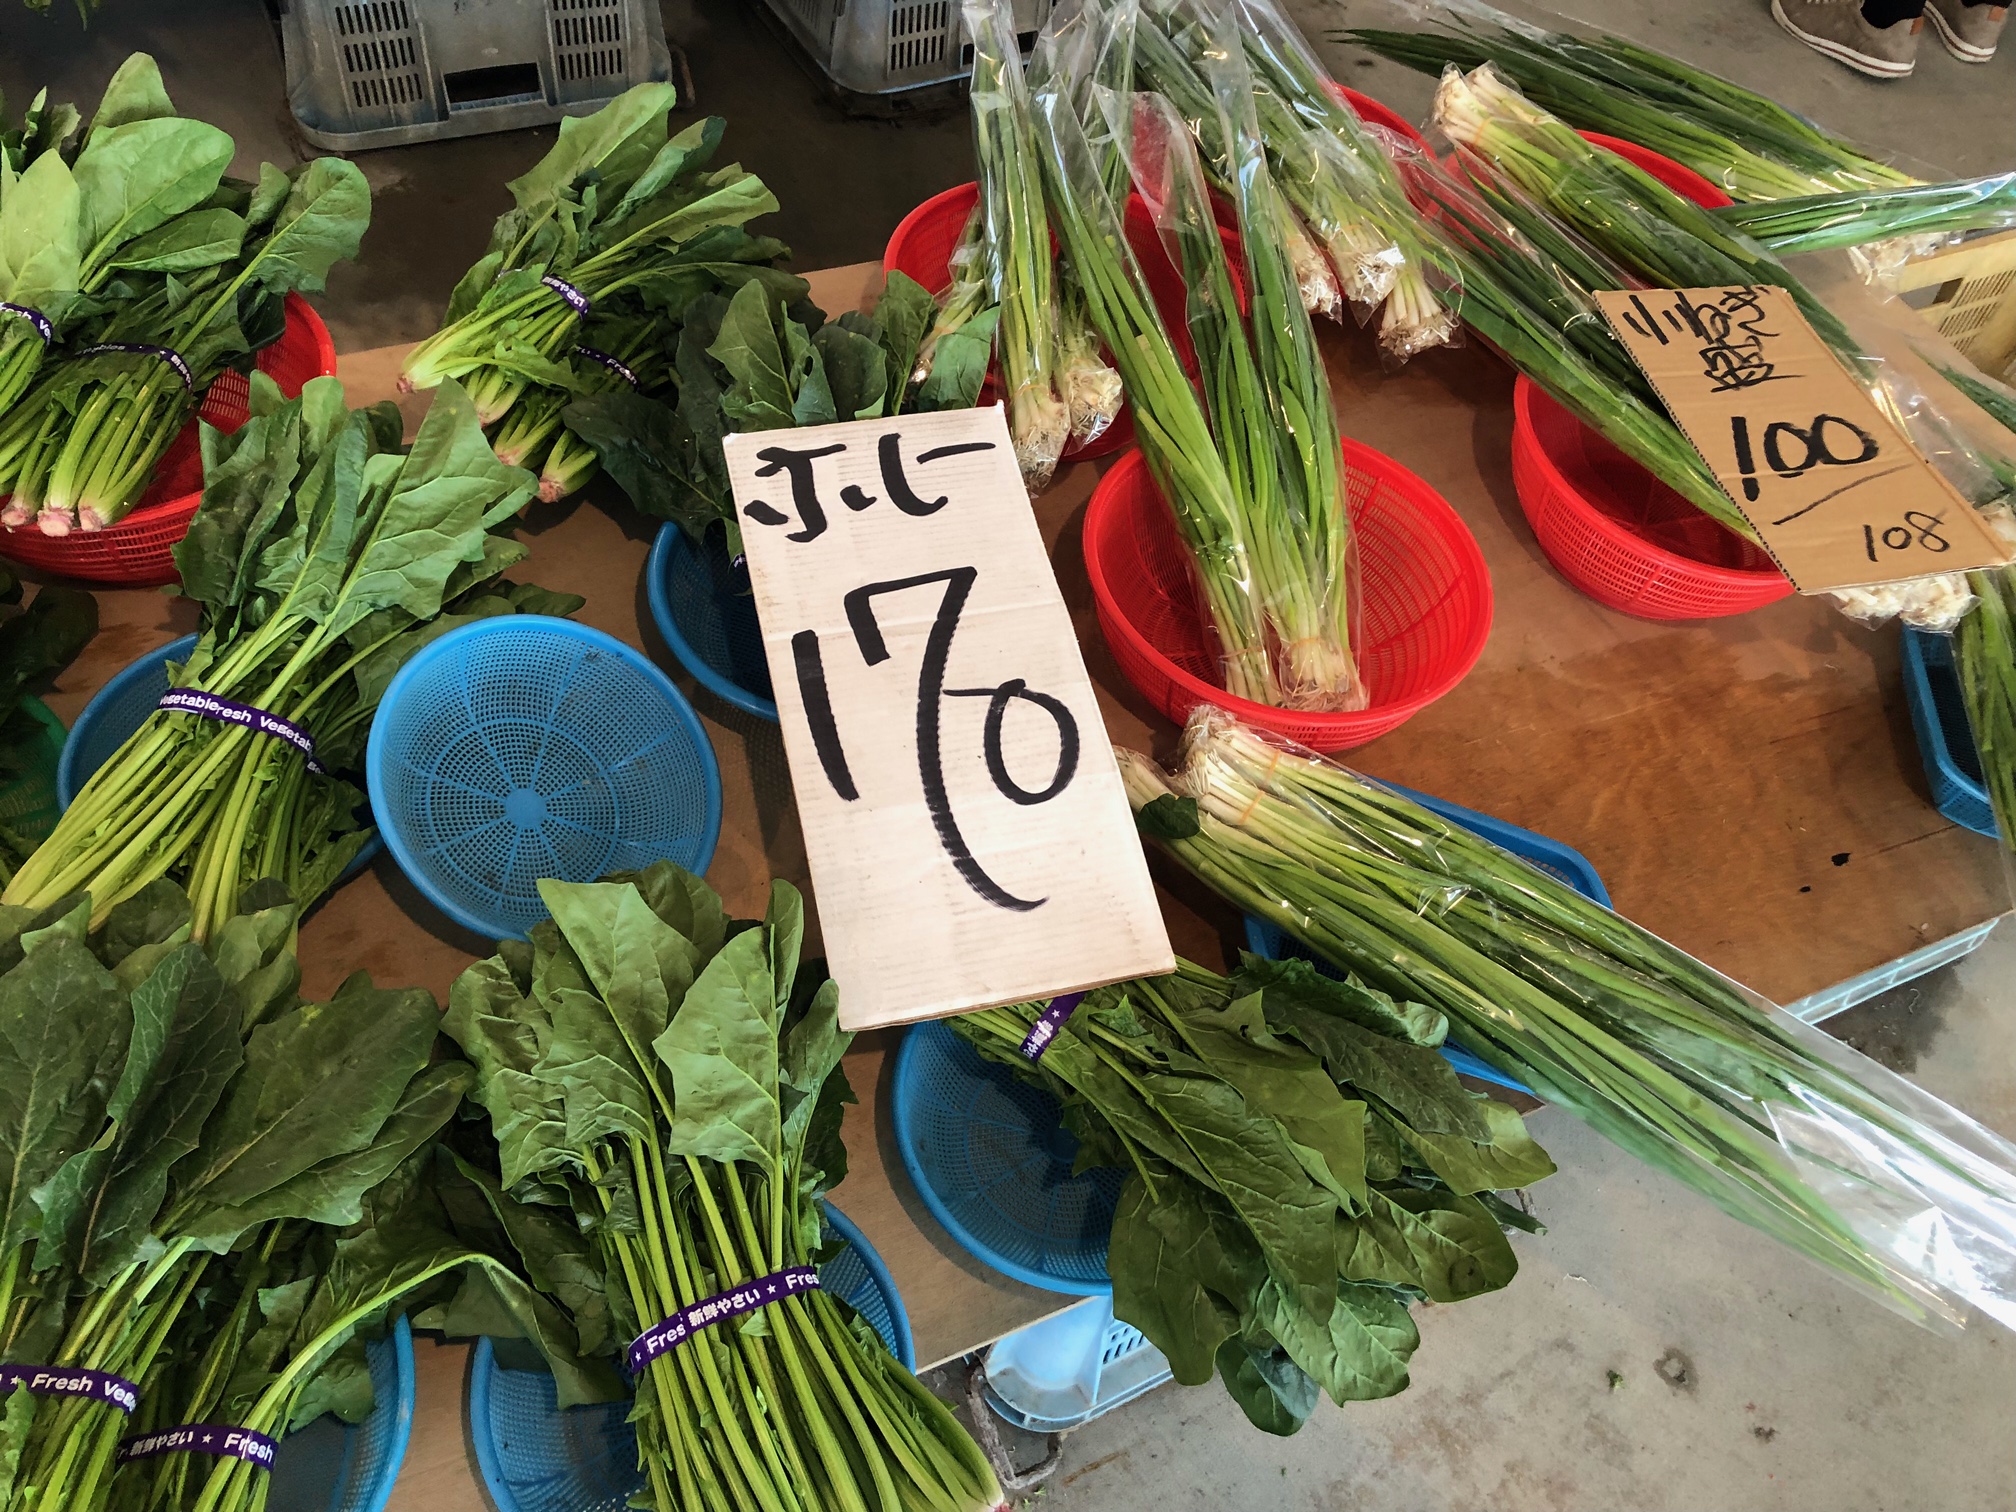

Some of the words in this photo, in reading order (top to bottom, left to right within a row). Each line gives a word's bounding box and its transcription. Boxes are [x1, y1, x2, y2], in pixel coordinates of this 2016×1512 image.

[1731, 413, 1880, 502] 100
[1862, 507, 1950, 562] 108
[791, 565, 1080, 912] 170
[687, 1288, 761, 1328] 新鮮やさい
[30, 1373, 93, 1392] Fresh
